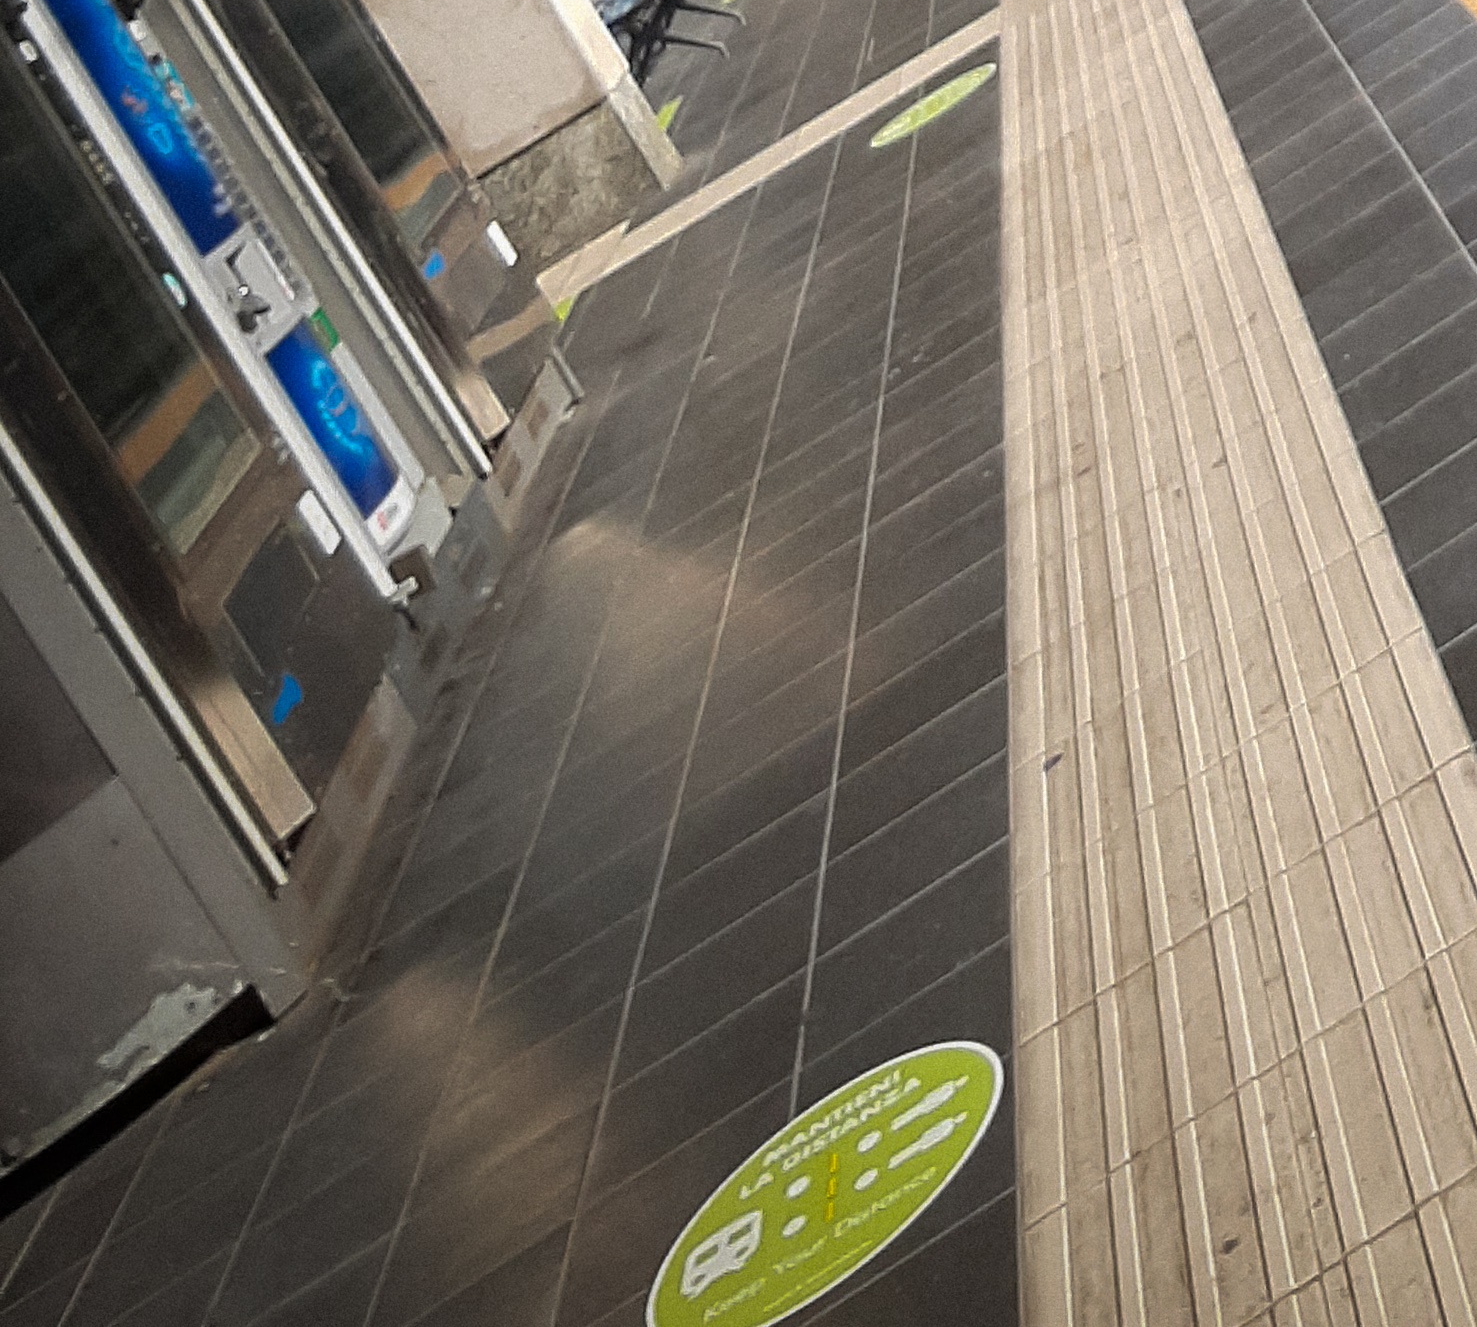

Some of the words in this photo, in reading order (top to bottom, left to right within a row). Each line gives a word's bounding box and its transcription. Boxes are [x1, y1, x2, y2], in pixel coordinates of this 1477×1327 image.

[739, 1170, 775, 1201] LA
[781, 1076, 922, 1172] DISTANZA
[763, 1068, 900, 1166] MANTIENI
